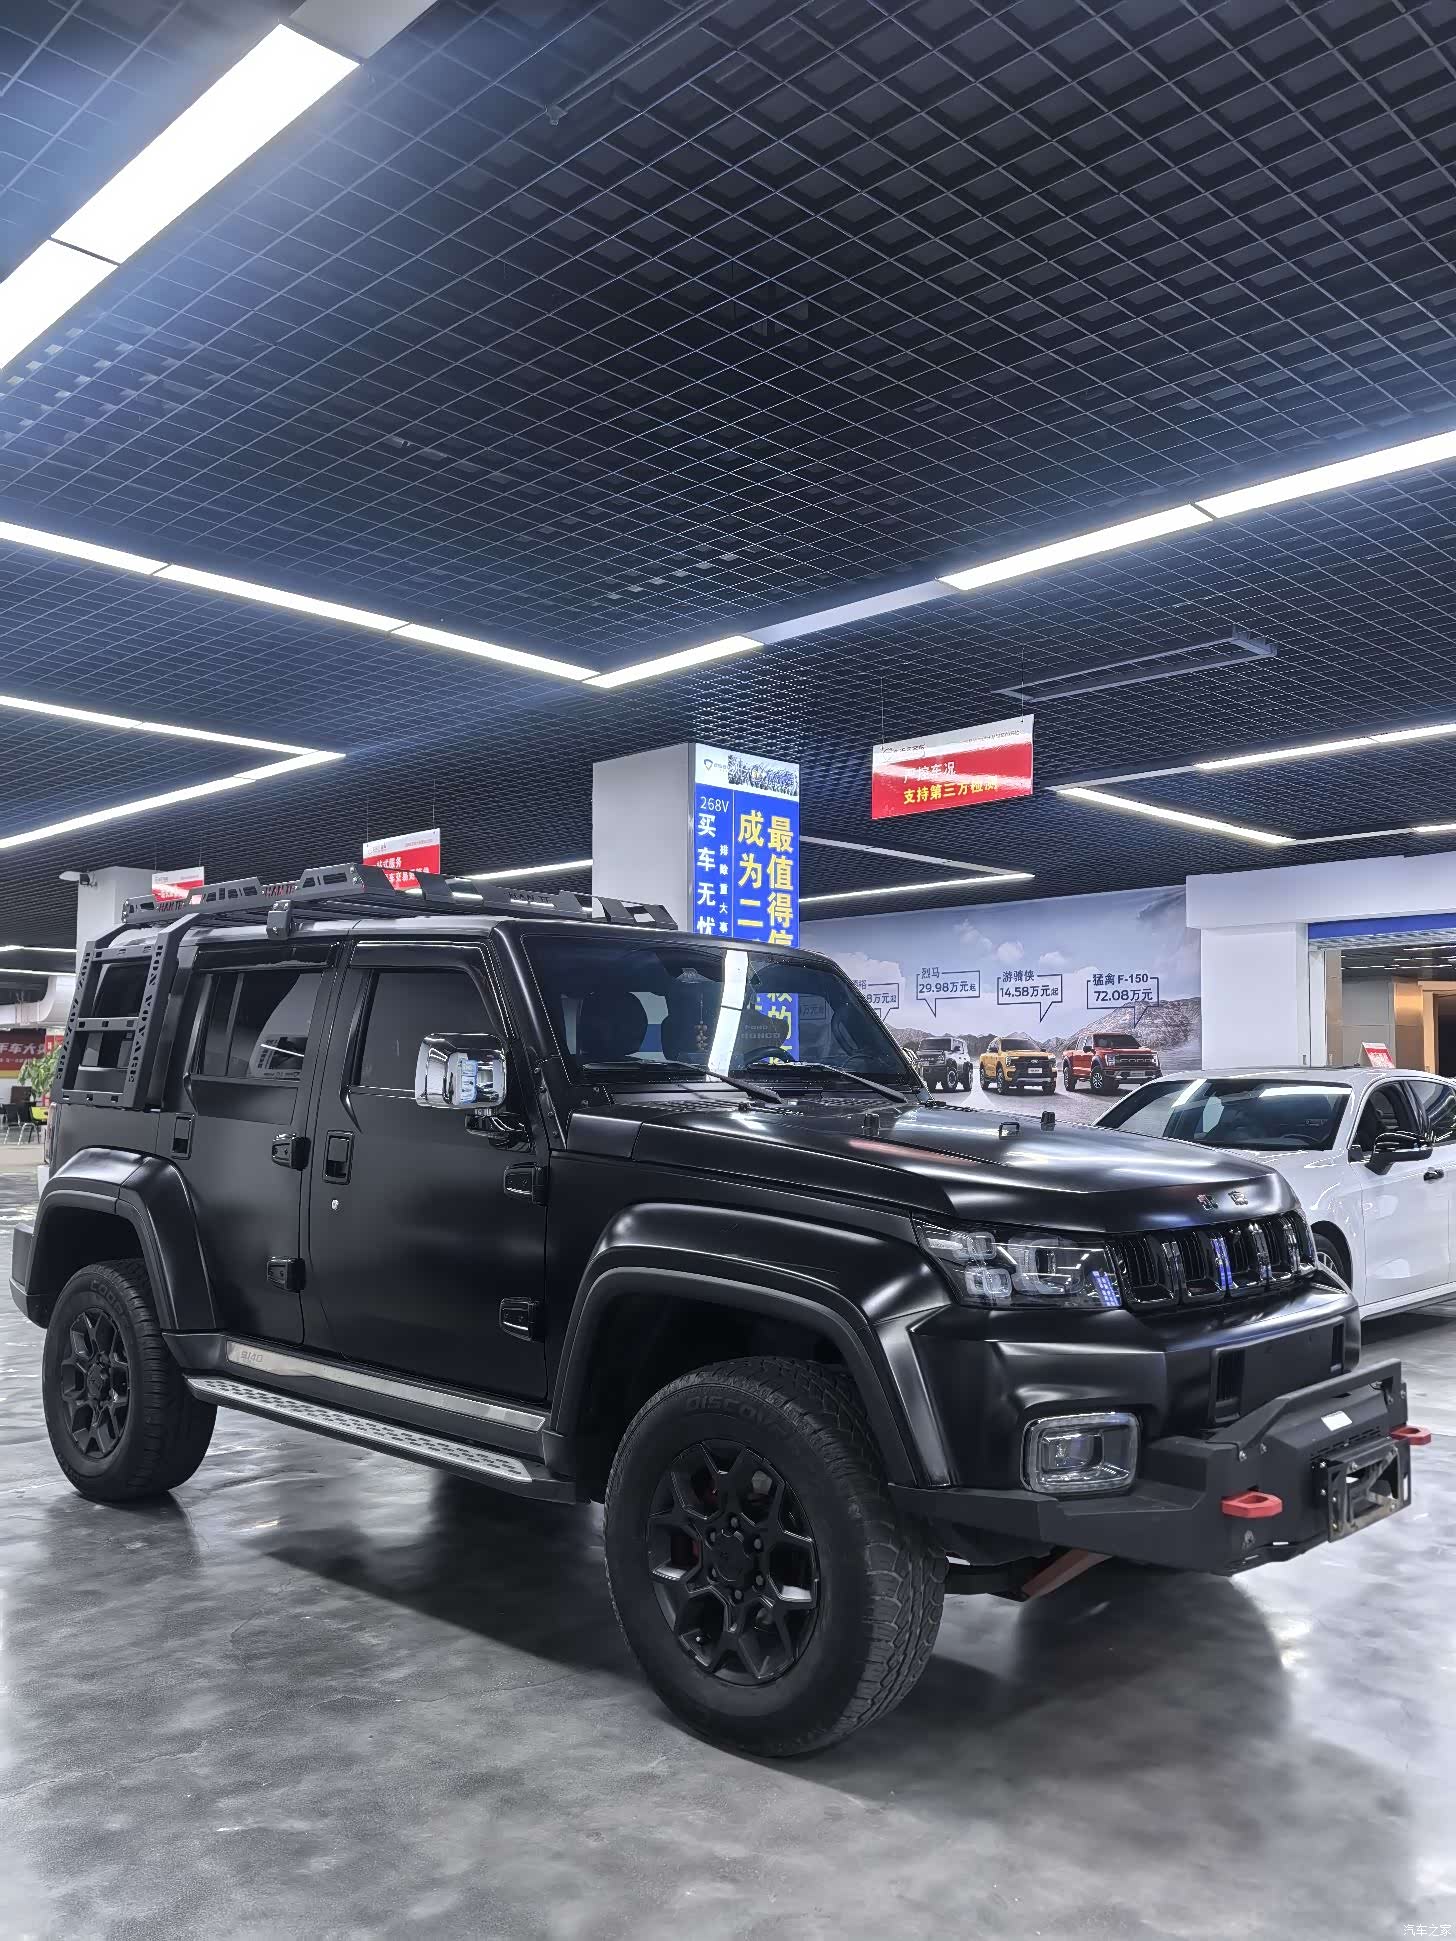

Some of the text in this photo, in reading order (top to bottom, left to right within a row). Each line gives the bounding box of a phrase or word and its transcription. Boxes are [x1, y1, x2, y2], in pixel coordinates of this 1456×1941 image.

[700, 796, 730, 813] 268V
[921, 967, 940, 980] 烈马
[1117, 973, 1149, 985] F-150
[918, 980, 977, 994] 29.98万元起
[1000, 983, 1059, 998] 14.58万元起
[1093, 987, 1154, 1002] 72.08万元
